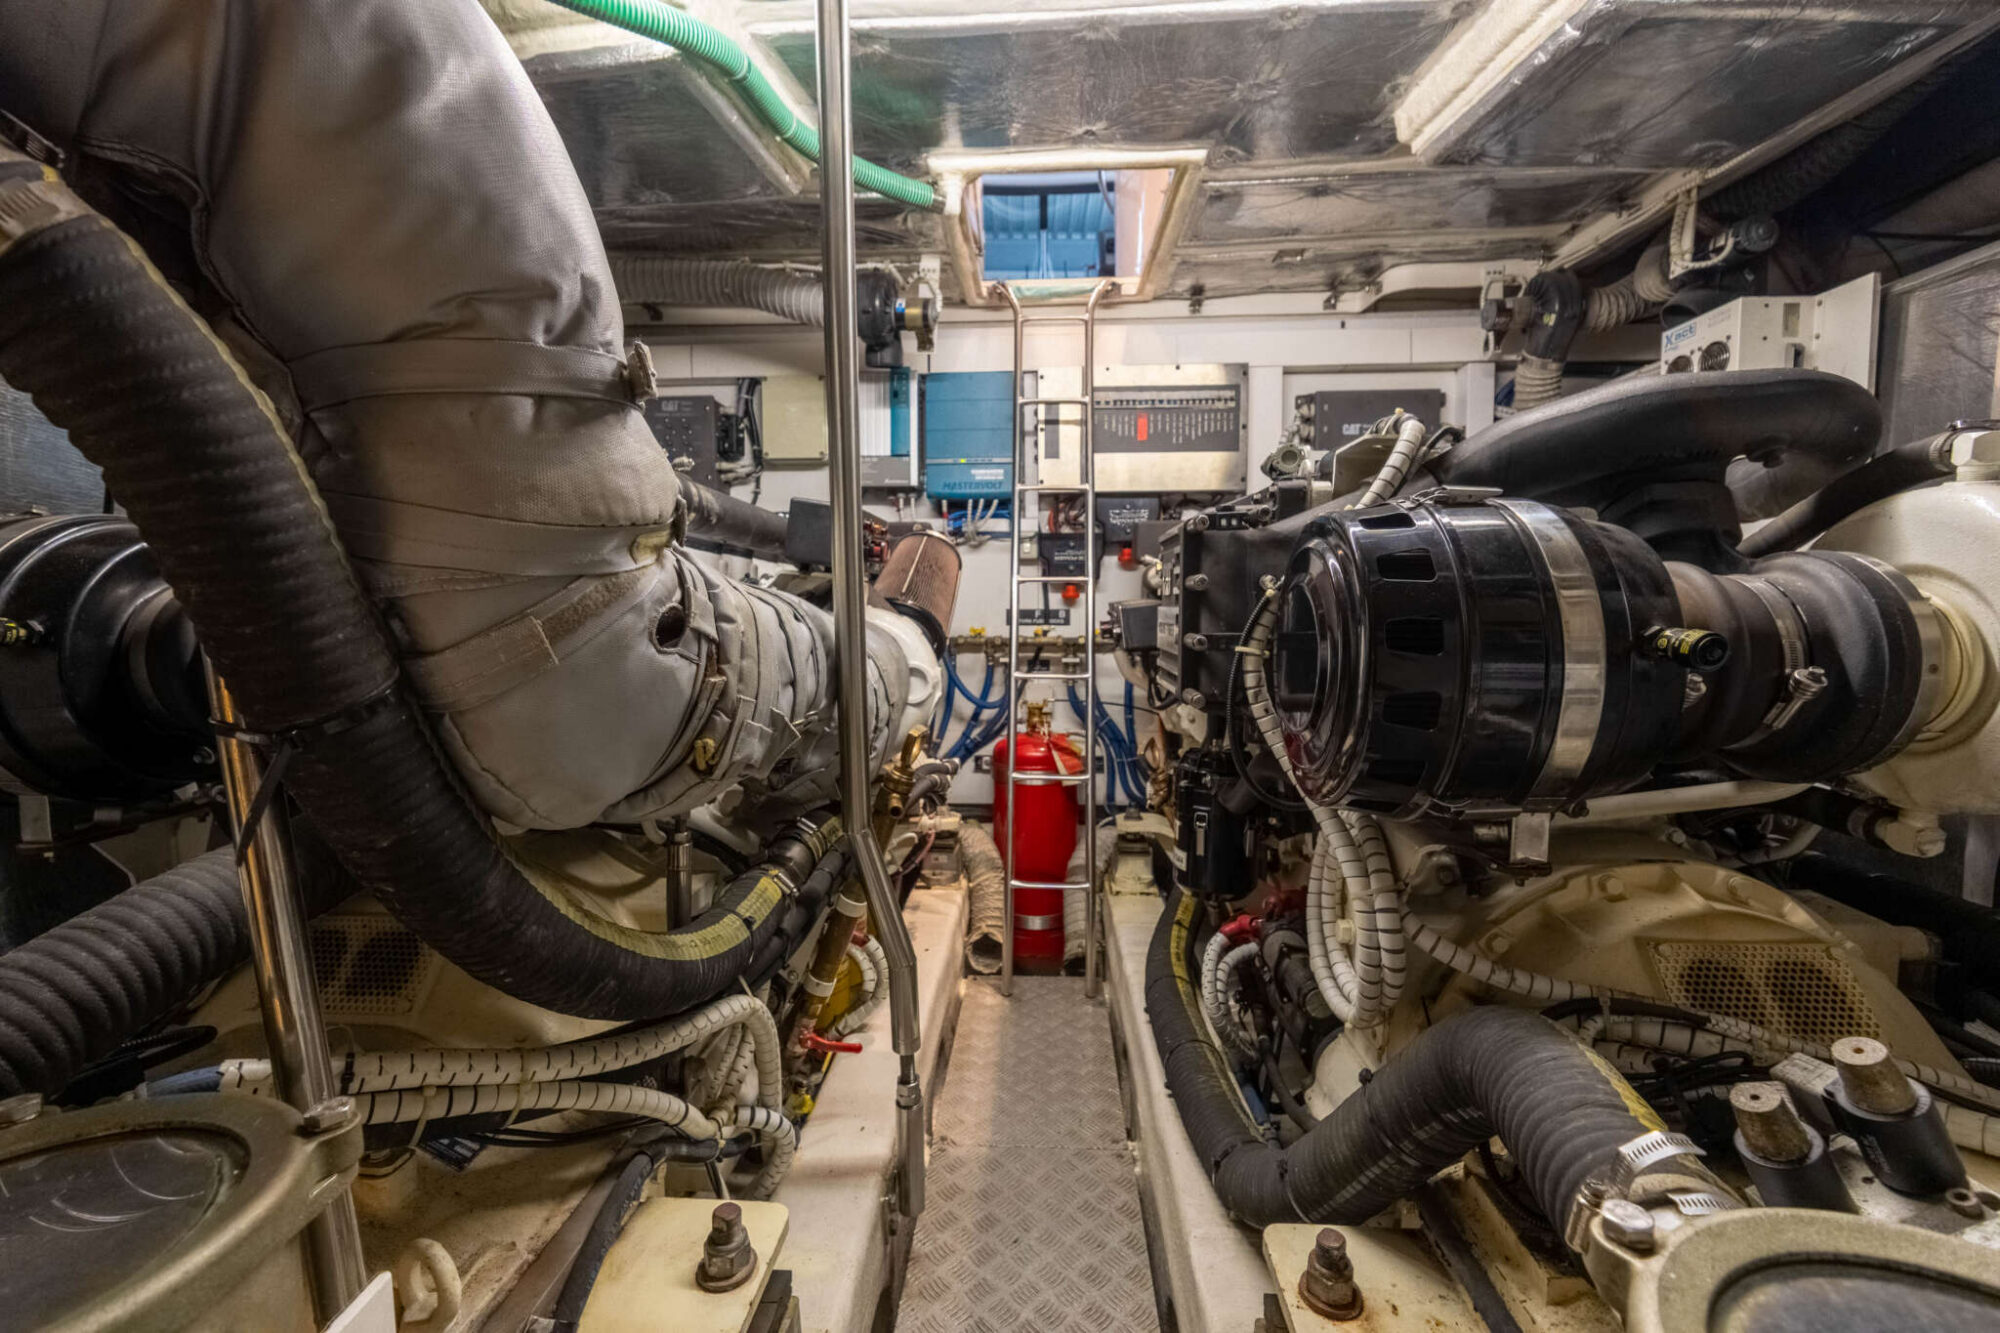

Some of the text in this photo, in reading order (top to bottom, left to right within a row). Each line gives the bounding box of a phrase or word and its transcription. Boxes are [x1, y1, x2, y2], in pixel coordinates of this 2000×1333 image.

[661, 400, 679, 411] CAT
[1342, 423, 1361, 435] CAT
[942, 480, 1003, 491] MASTERVOLT
